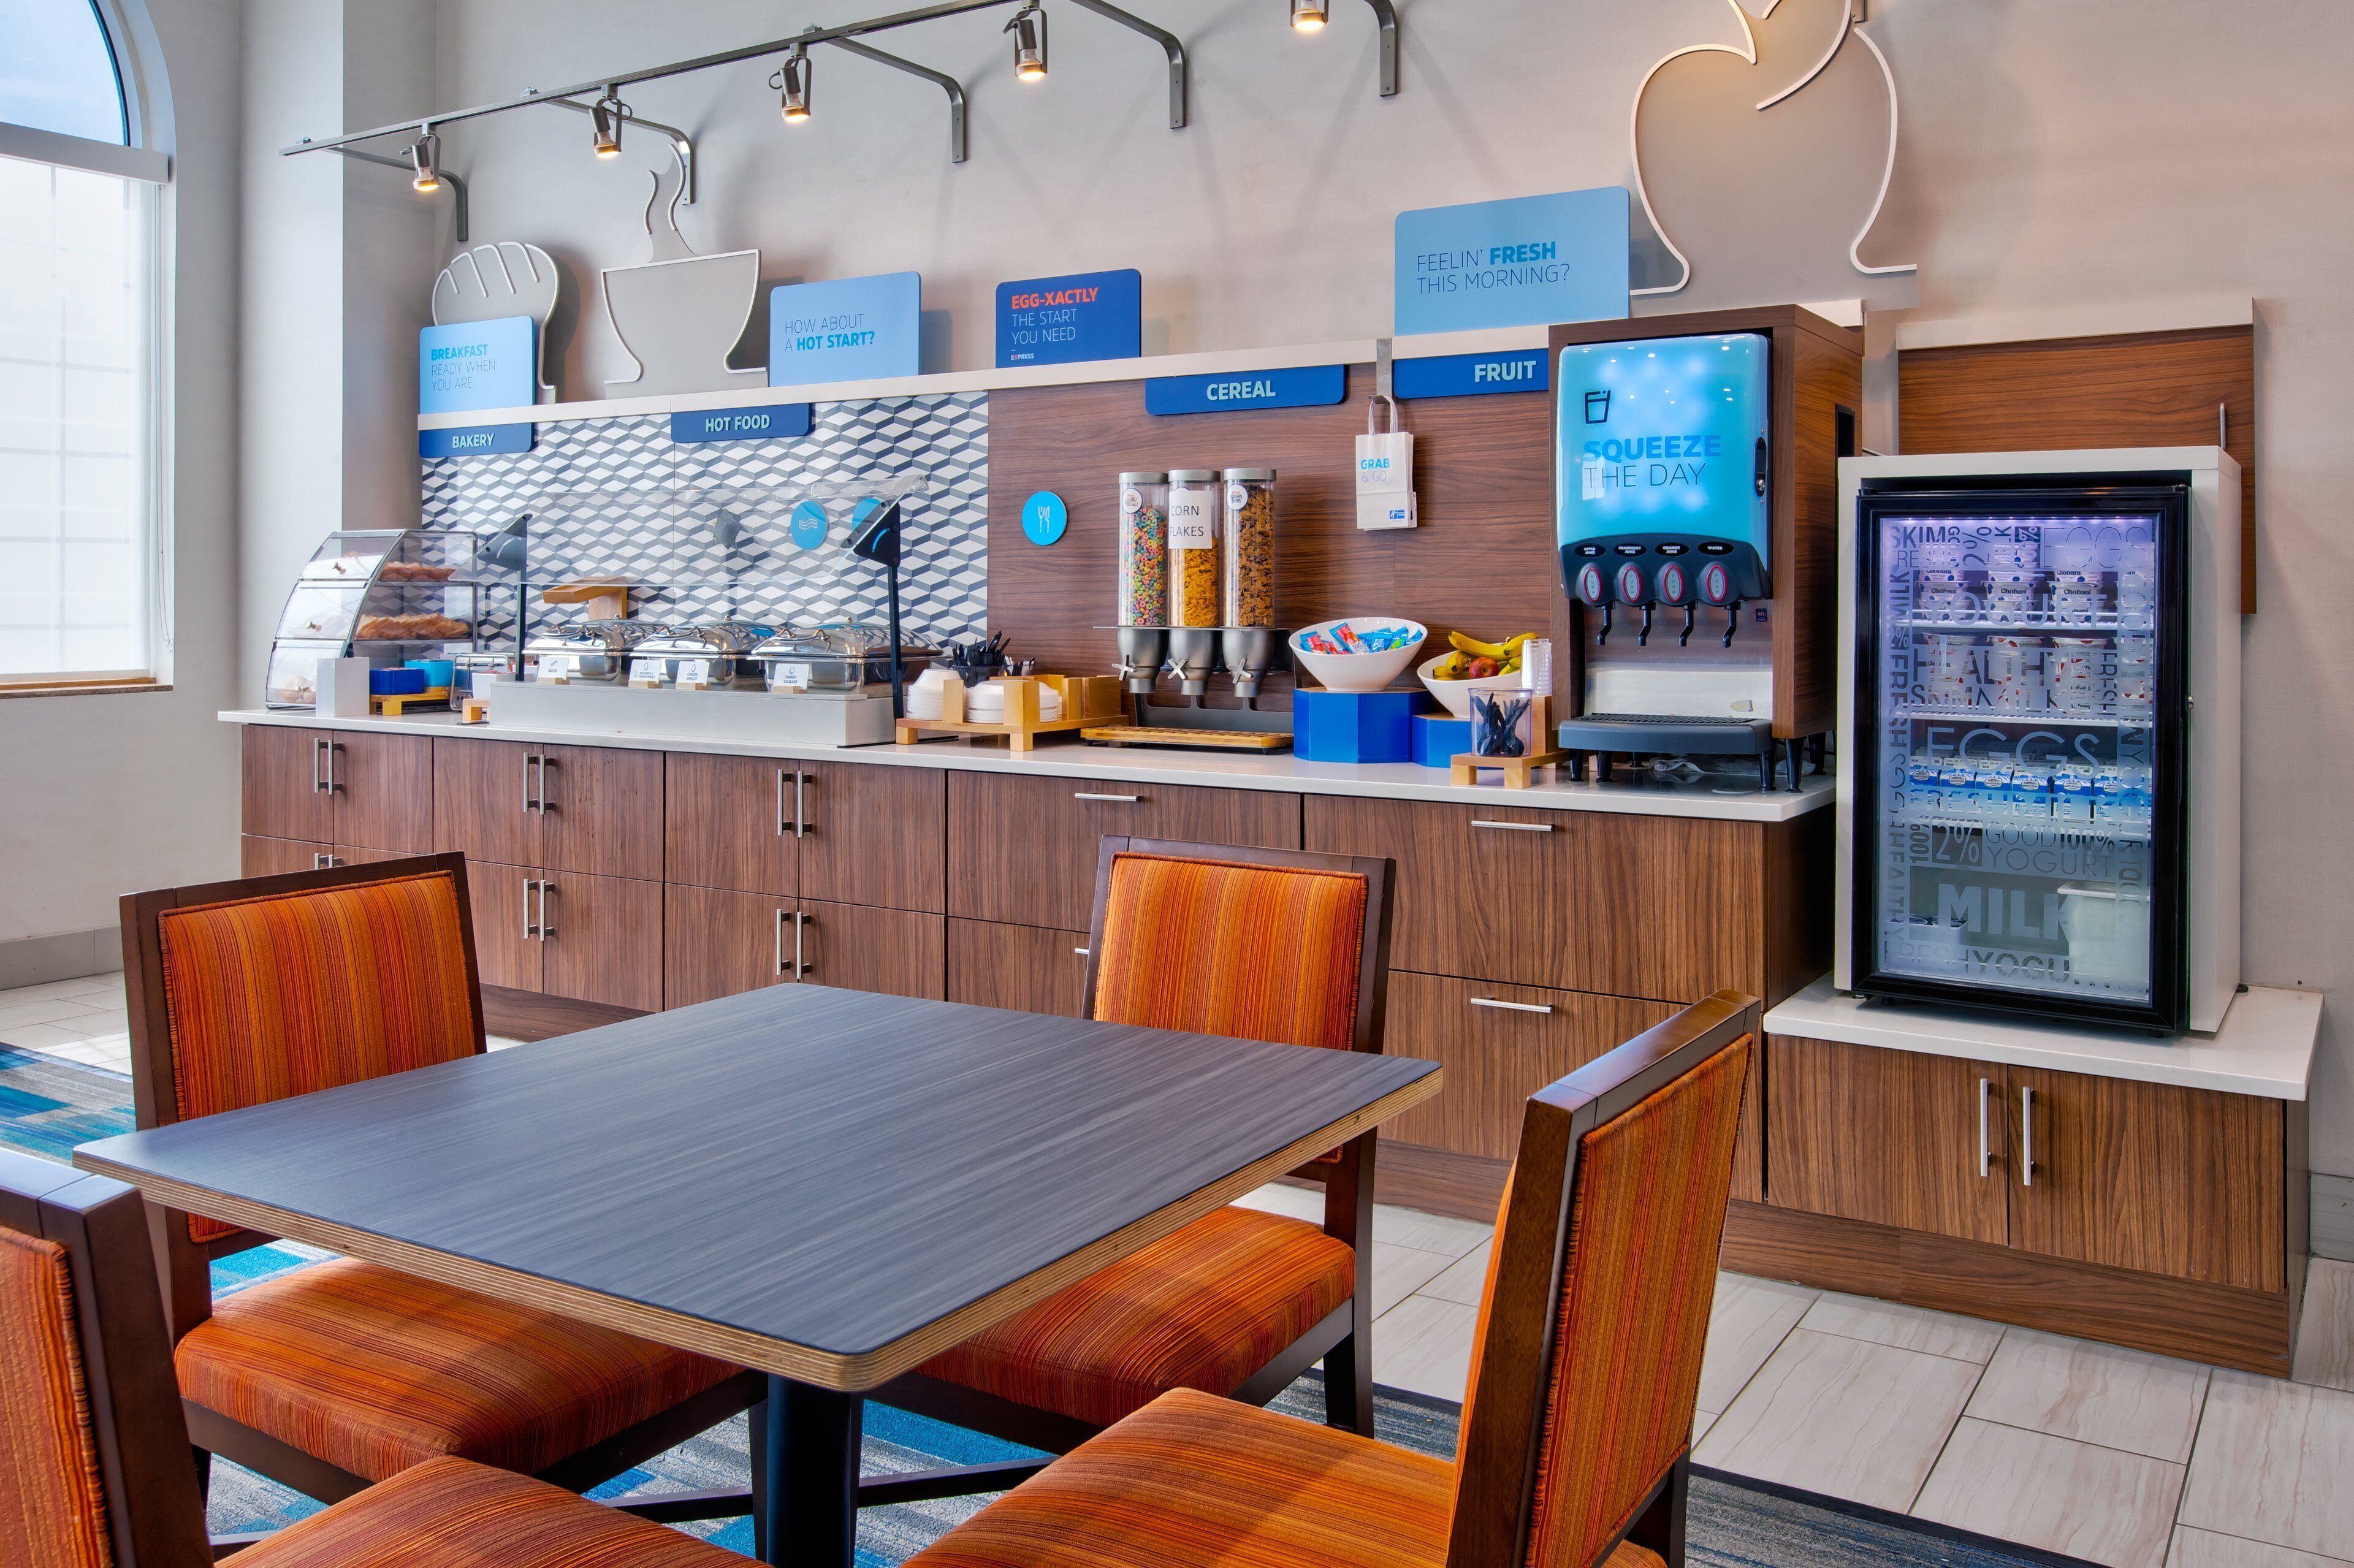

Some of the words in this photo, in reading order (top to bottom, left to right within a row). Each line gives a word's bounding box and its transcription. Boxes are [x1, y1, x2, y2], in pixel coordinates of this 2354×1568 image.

[1417, 248, 1483, 272] FEELIN'
[1490, 241, 1556, 265] FRESH
[1417, 275, 1457, 295] THIS
[1465, 263, 1570, 291] MORNING?
[1011, 287, 1099, 309] EGG-XACTLY
[785, 318, 816, 334] HOW
[820, 313, 864, 331] ABOUT
[1011, 312, 1035, 327] THE
[1039, 308, 1077, 325] START
[785, 338, 793, 352] A
[797, 335, 823, 351] HOT
[827, 330, 875, 349] START?
[1011, 330, 1038, 344] YOU
[1043, 327, 1076, 342] NEED
[431, 343, 489, 361] BREAKFAST
[431, 362, 462, 376] READY
[466, 359, 495, 373] WHEN
[1475, 360, 1537, 382] FRUIT
[431, 379, 451, 392] YOU
[454, 376, 473, 390] ARE
[1206, 380, 1276, 401] CEREAL
[706, 417, 731, 432] HOT
[734, 414, 771, 430] FOOD
[452, 433, 495, 449] BAKERY
[1584, 435, 1721, 463] SQUEEZE
[1360, 458, 1390, 470] GRAB
[1362, 471, 1369, 482] &
[1372, 470, 1387, 482] GO
[1583, 465, 1637, 489] THE
[1650, 462, 1706, 486] DAY
[1171, 505, 1200, 516] CORN
[1170, 525, 1204, 536] FLAKES
[1889, 525, 1946, 549] SKIM
[2044, 526, 2148, 569] EGGS
[1924, 592, 2107, 628] YOGURT
[1889, 655, 1908, 748] FRESH
[1927, 727, 2100, 779] EGGS
[1935, 821, 1979, 864] 2%
[1986, 821, 2056, 848] GOOD
[2060, 827, 2115, 853] 100%
[1987, 845, 2112, 878] YOGURT
[1938, 883, 2082, 942] MILK
